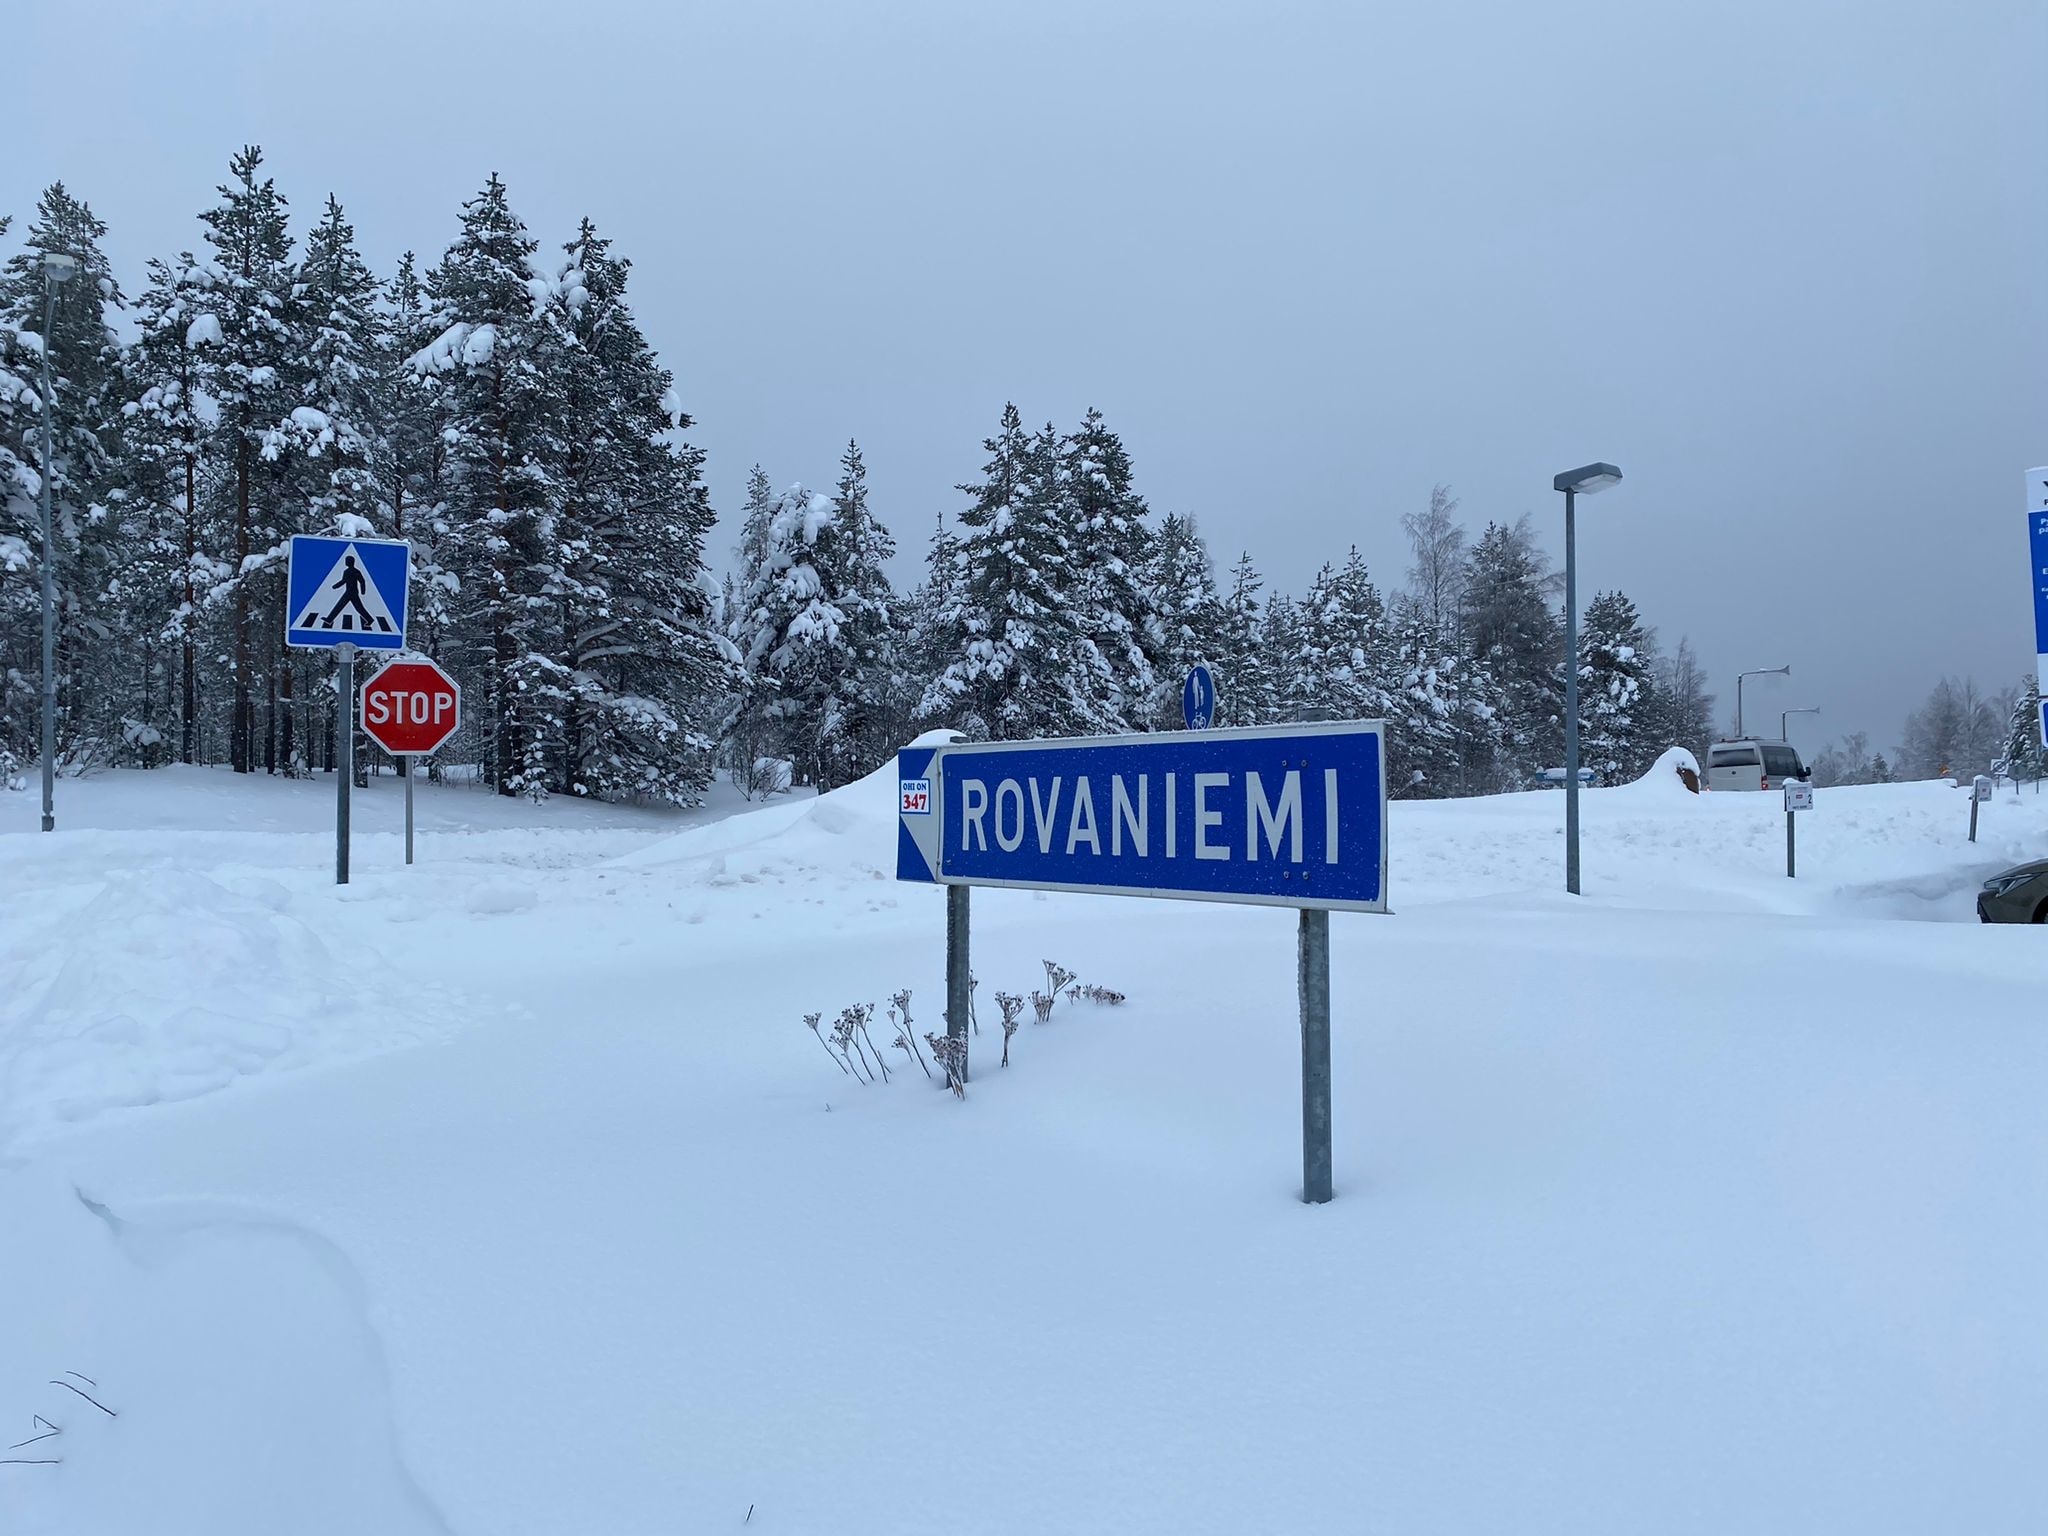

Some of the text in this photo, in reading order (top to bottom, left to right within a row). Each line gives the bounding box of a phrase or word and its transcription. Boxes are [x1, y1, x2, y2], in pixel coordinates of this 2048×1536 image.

[368, 690, 453, 724] STOP
[916, 782, 927, 791] ON
[903, 793, 927, 810] 347
[962, 768, 1338, 865] ROVANIEMI
